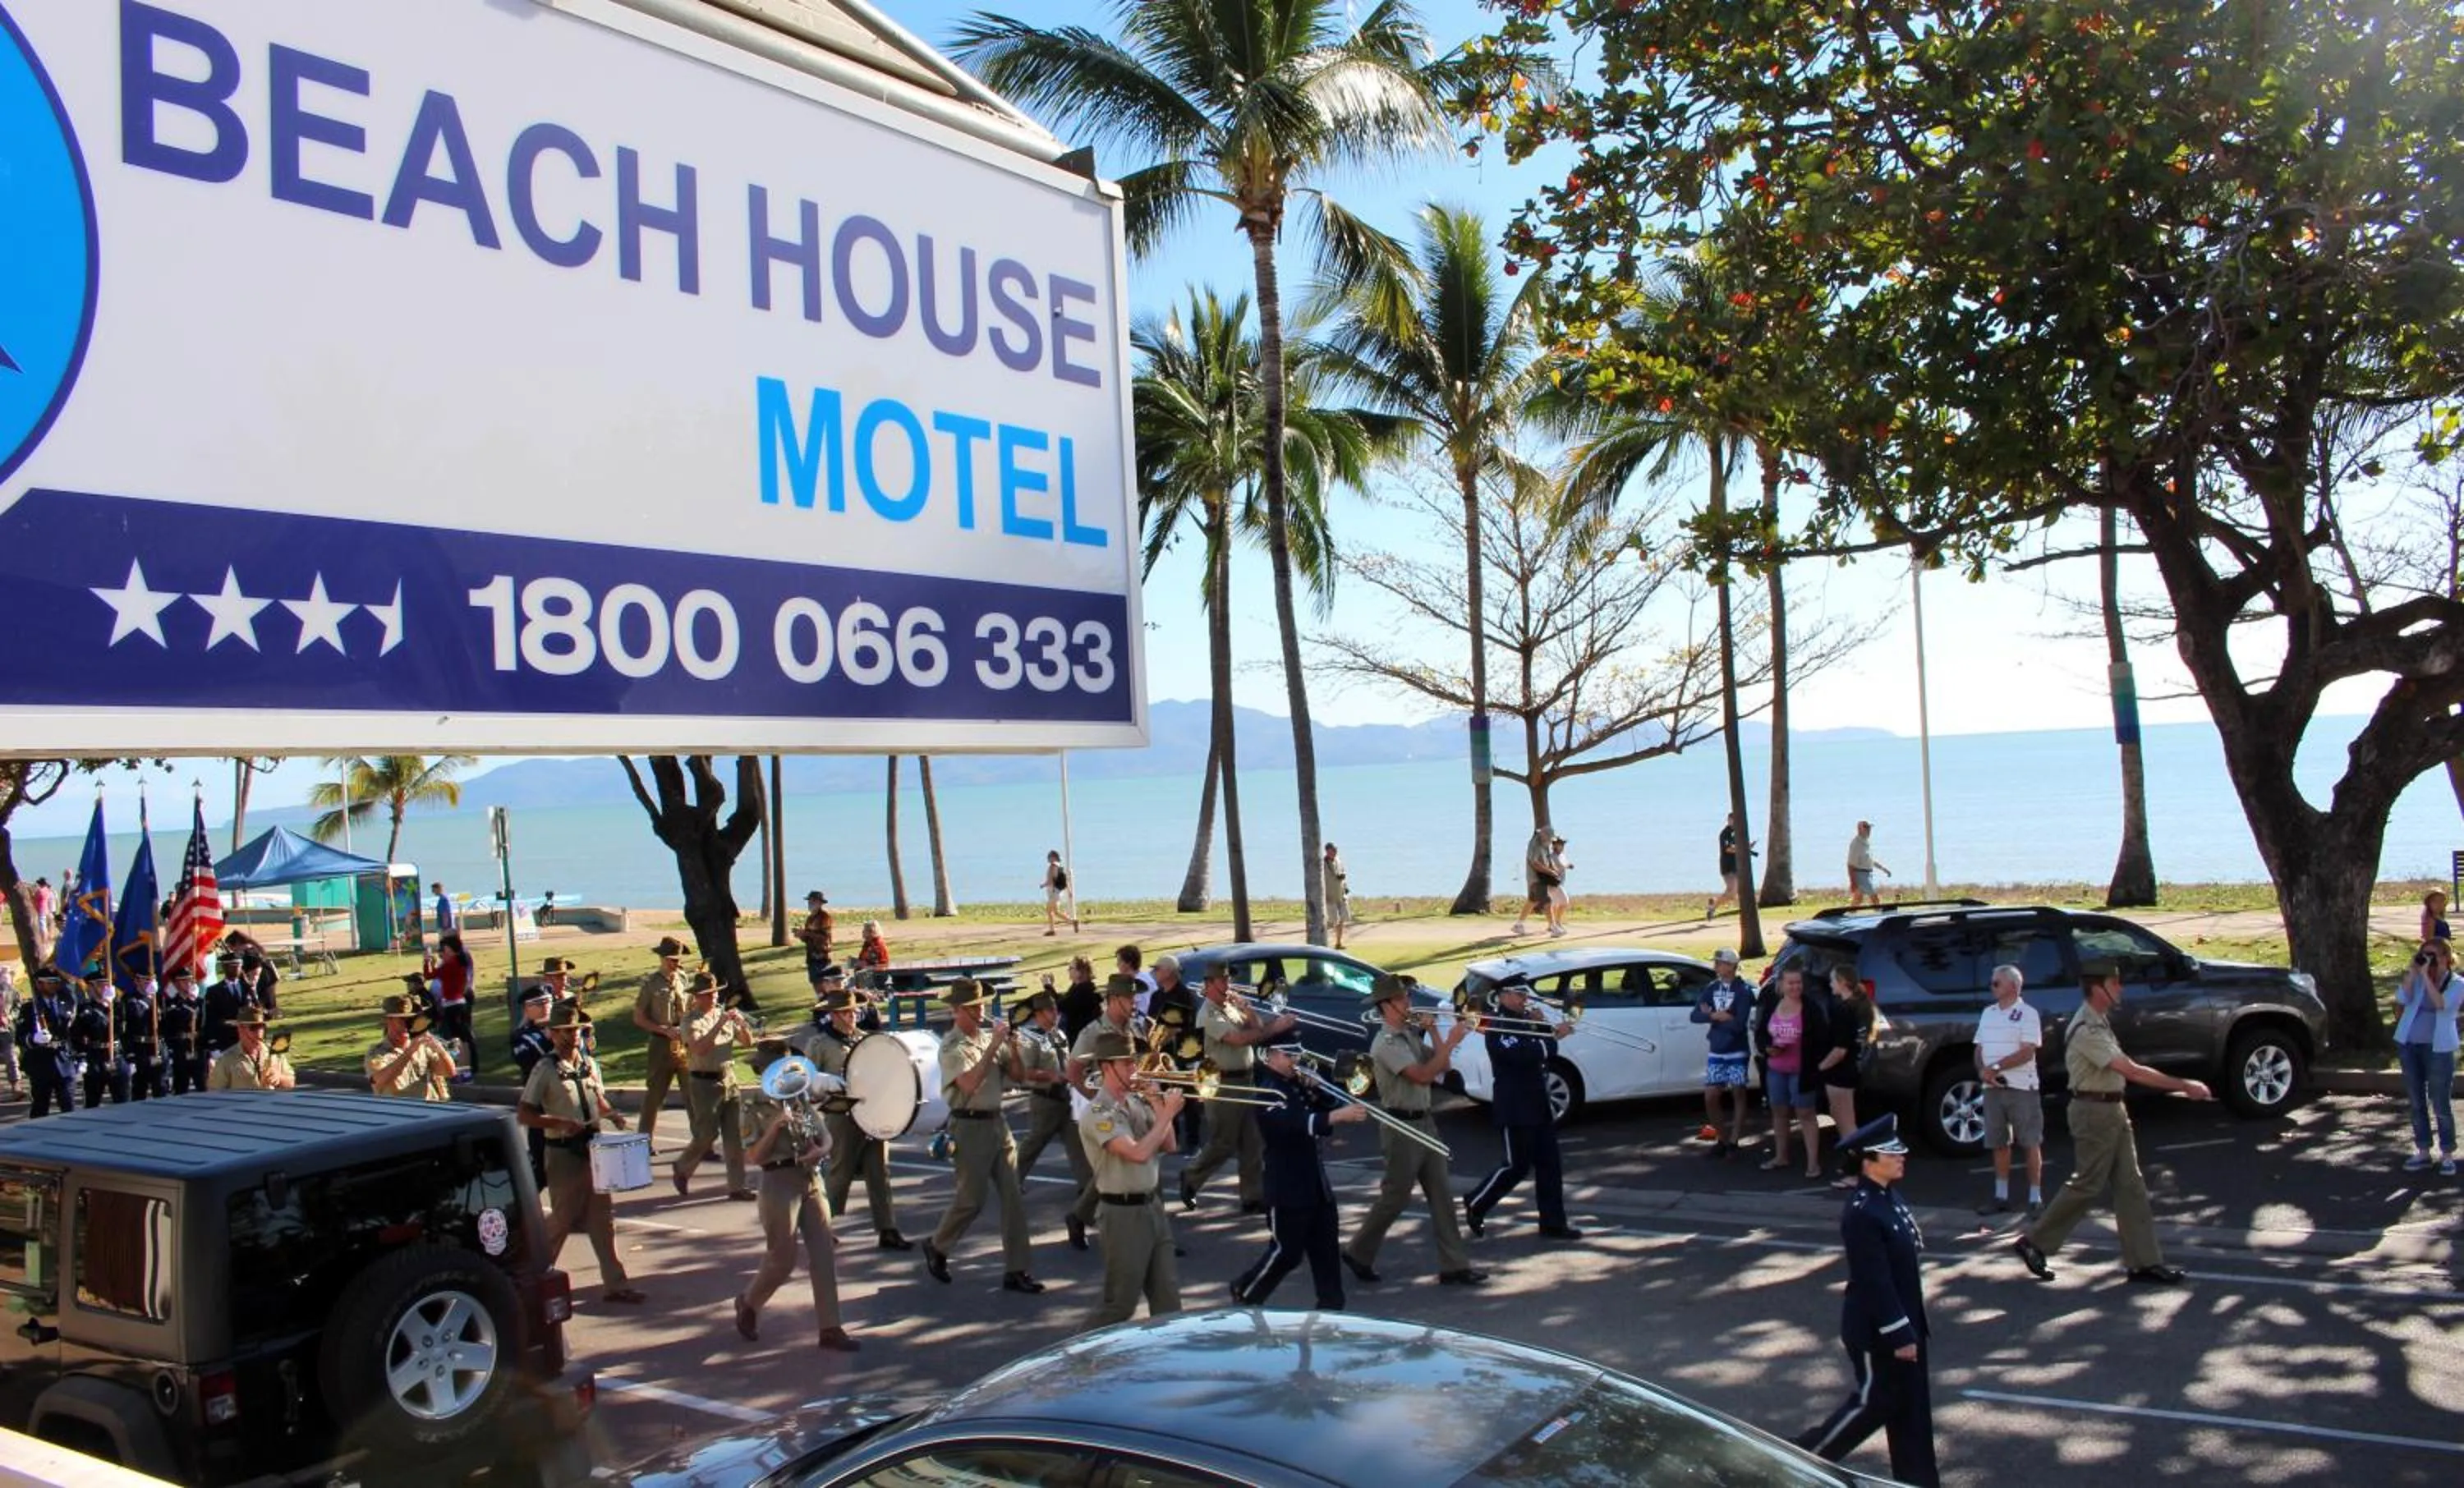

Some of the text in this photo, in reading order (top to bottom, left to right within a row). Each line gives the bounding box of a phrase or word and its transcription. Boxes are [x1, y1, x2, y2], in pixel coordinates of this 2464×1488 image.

[119, 0, 1102, 389] BEACH HOUSE
[755, 374, 1109, 549] MOTEL
[469, 575, 1115, 693] 1800 066 333
